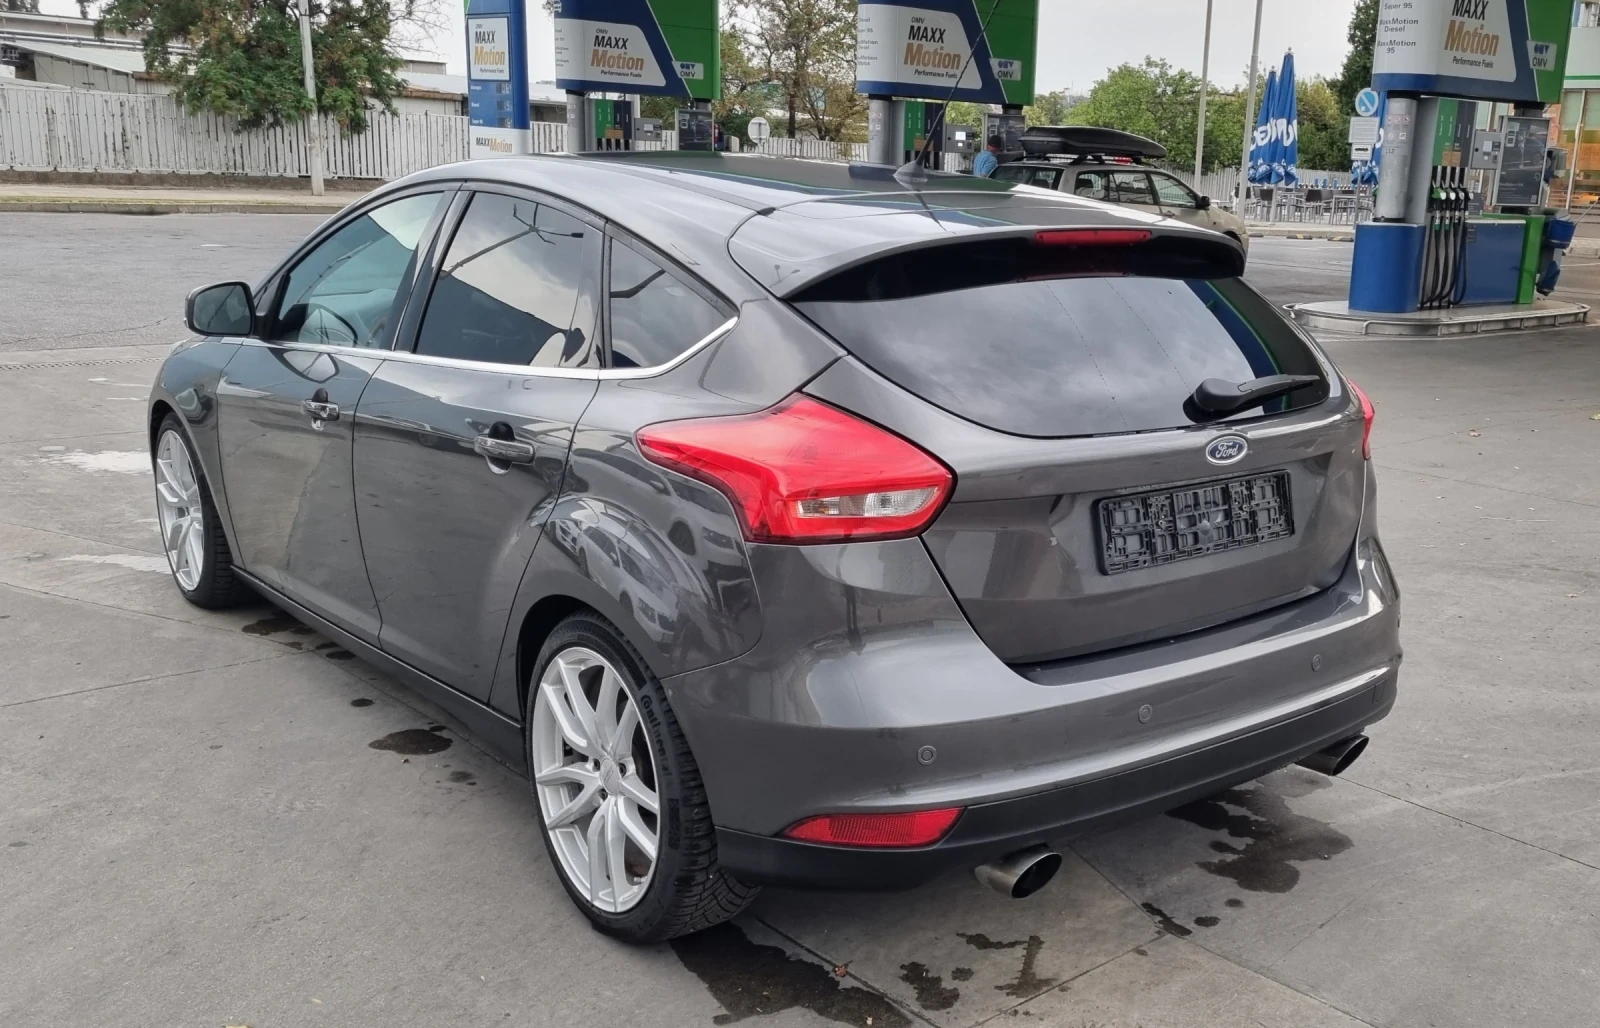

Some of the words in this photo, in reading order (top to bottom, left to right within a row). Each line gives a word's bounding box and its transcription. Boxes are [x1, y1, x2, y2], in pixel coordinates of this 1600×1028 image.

[1452, 0, 1489, 21] MAXX
[911, 16, 925, 24] OMV
[475, 30, 496, 44] MAXX
[595, 27, 609, 35] OMV
[908, 25, 946, 44] MAXX
[1444, 20, 1500, 57] Motion
[593, 34, 629, 51] MAXX
[474, 45, 506, 66] Motion
[590, 48, 645, 71] Motion
[903, 42, 962, 70] Motion
[1452, 55, 1481, 67] Performance
[1481, 58, 1494, 68] Fuels
[1532, 57, 1548, 68] OMV
[600, 69, 629, 78] Performance
[679, 70, 696, 78] OMV
[914, 69, 945, 78] Performance
[945, 71, 958, 79] Fuels
[997, 70, 1014, 79] OMV
[1215, 442, 1239, 458] Ford
[640, 695, 672, 776] Continental
